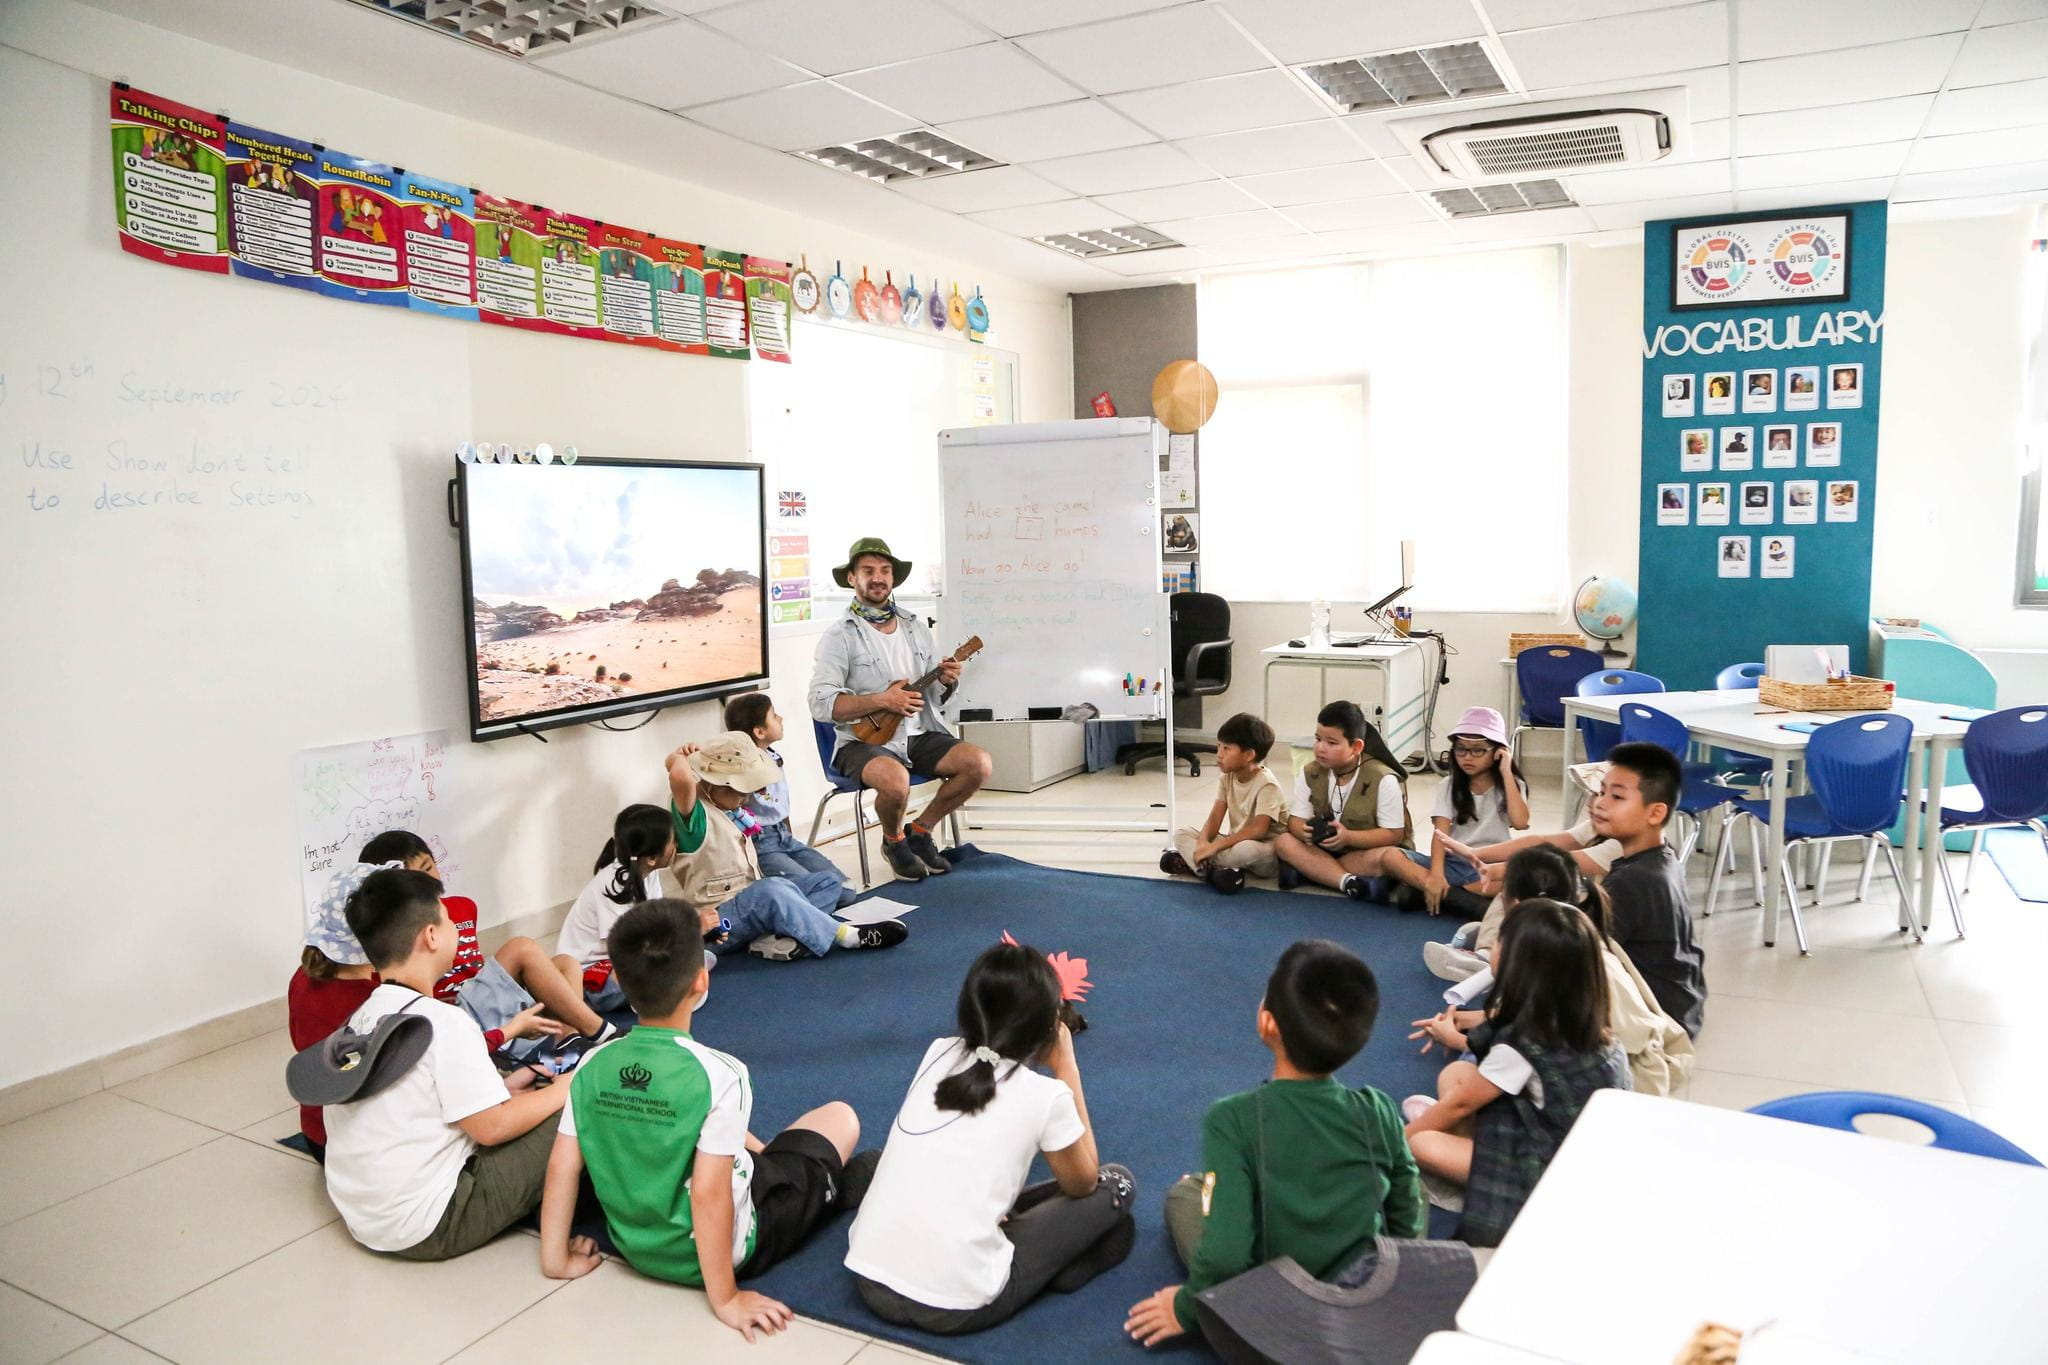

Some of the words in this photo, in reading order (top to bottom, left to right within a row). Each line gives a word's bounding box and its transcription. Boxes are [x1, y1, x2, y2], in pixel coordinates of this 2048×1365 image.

[119, 98, 177, 128] Talking
[178, 117, 219, 139] Chips
[226, 132, 282, 154] Numbered
[283, 147, 313, 162] Heads
[248, 147, 294, 166] Together
[140, 161, 163, 173] Teacher
[165, 169, 192, 180] Provides
[322, 161, 392, 187] RoundRobin
[140, 179, 152, 187] Any
[187, 191, 201, 199] Uses
[140, 185, 163, 197] Talking
[165, 192, 180, 200] Chip
[408, 184, 462, 206] Fan-N-Pick
[141, 201, 174, 214] Teammates
[175, 209, 186, 217] Use
[141, 207, 158, 217] Chips
[166, 214, 179, 222] Any
[180, 217, 199, 226] Order
[141, 223, 175, 236] Teammates
[175, 231, 197, 241] Collect
[141, 229, 158, 239] Chips
[171, 237, 200, 247] Continue
[605, 233, 620, 242] One
[622, 237, 642, 248] Stray
[1684, 233, 1712, 259] GLOBAL
[706, 256, 741, 270] RallyCoach
[1706, 260, 1730, 270] BVIS
[1790, 254, 1814, 264] BVIS
[1684, 274, 1715, 299] VIETNAMESE
[1642, 310, 1887, 359] VOCABULARY
[116, 370, 245, 412] September
[19, 440, 74, 471] Use
[26, 487, 61, 512] to
[93, 479, 202, 512] describe
[964, 499, 1001, 521] Alice
[1015, 494, 1040, 516] the
[1053, 488, 1097, 516] camel
[965, 528, 992, 542] had
[1054, 517, 1100, 543] humps
[960, 558, 986, 577] Now
[1020, 553, 1050, 574] Alice
[303, 843, 320, 860] I'm
[321, 841, 342, 856] not
[309, 857, 334, 873] sure
[594, 1098, 645, 1114] INTERNATIONAL
[646, 1107, 678, 1118] SCHOOL
[600, 1091, 623, 1100] BRITISH
[624, 1096, 670, 1108] VIETNAMESE
